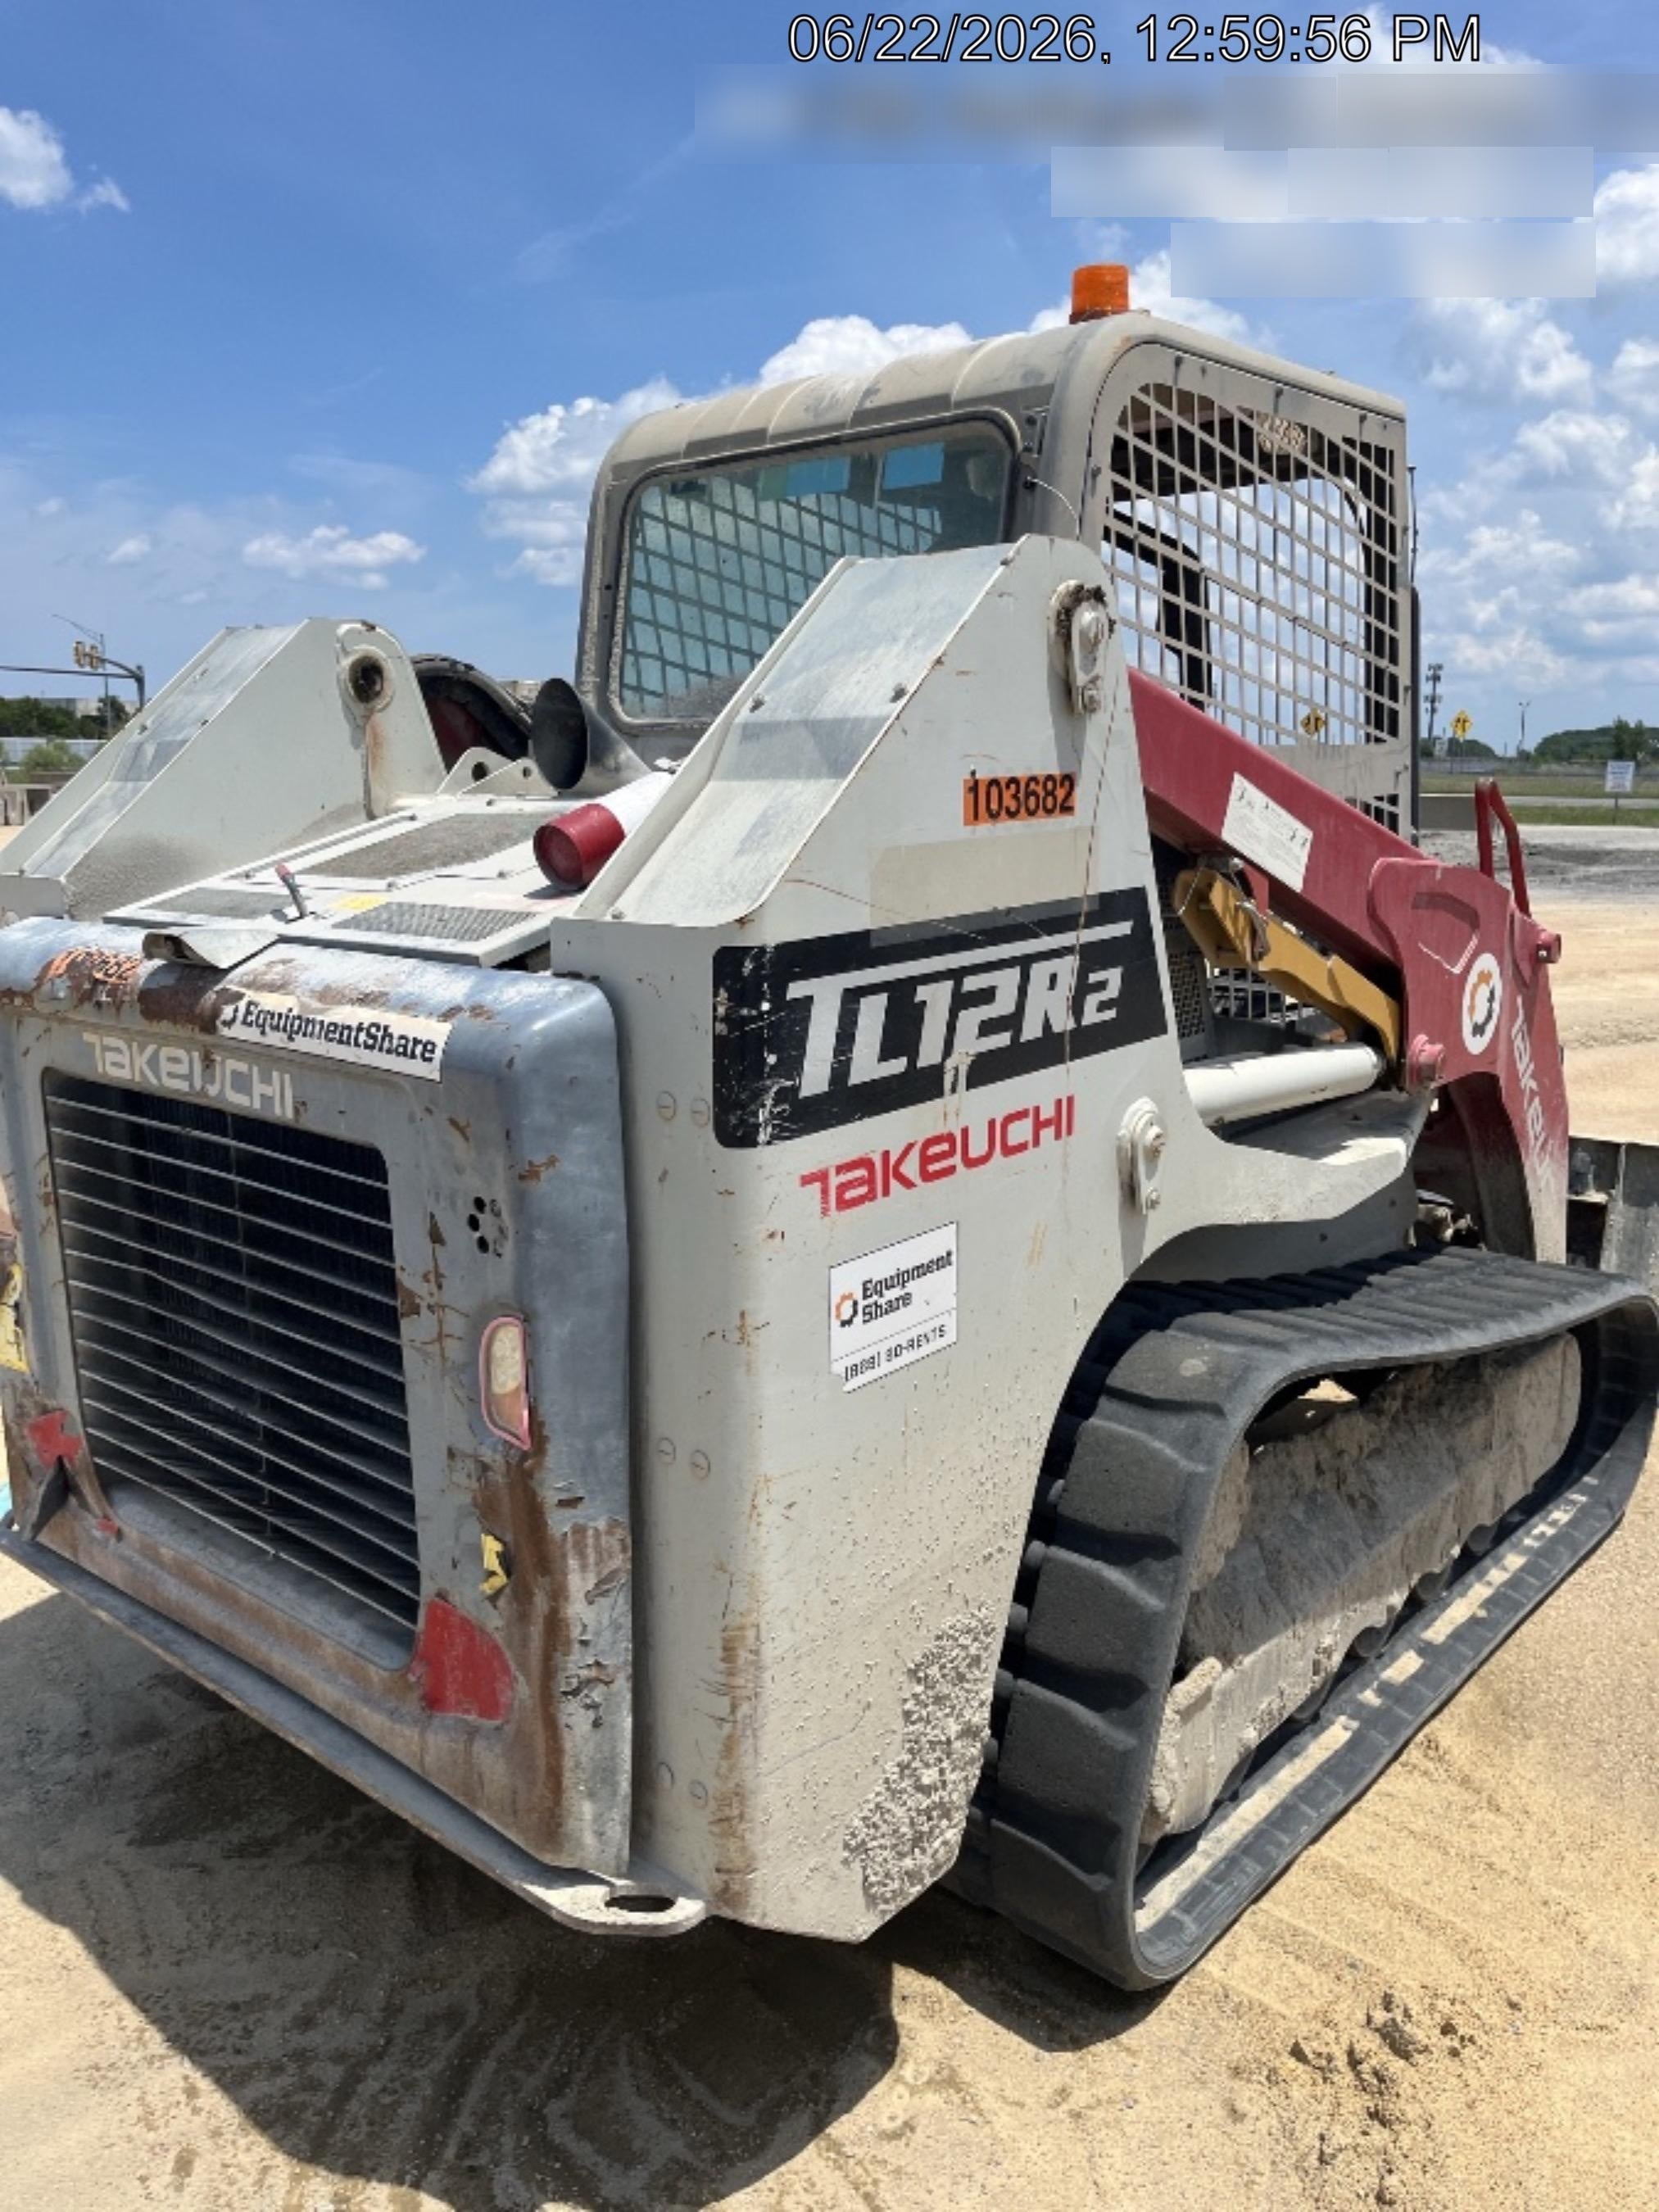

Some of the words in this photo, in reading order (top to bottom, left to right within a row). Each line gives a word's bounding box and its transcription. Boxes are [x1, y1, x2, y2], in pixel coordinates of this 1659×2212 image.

[968, 771, 1076, 821] 103682
[241, 999, 437, 1063] EquipmentShare
[786, 950, 1124, 1099] TL12R2
[863, 1249, 953, 1301] Equipment
[863, 1292, 913, 1325] Share
